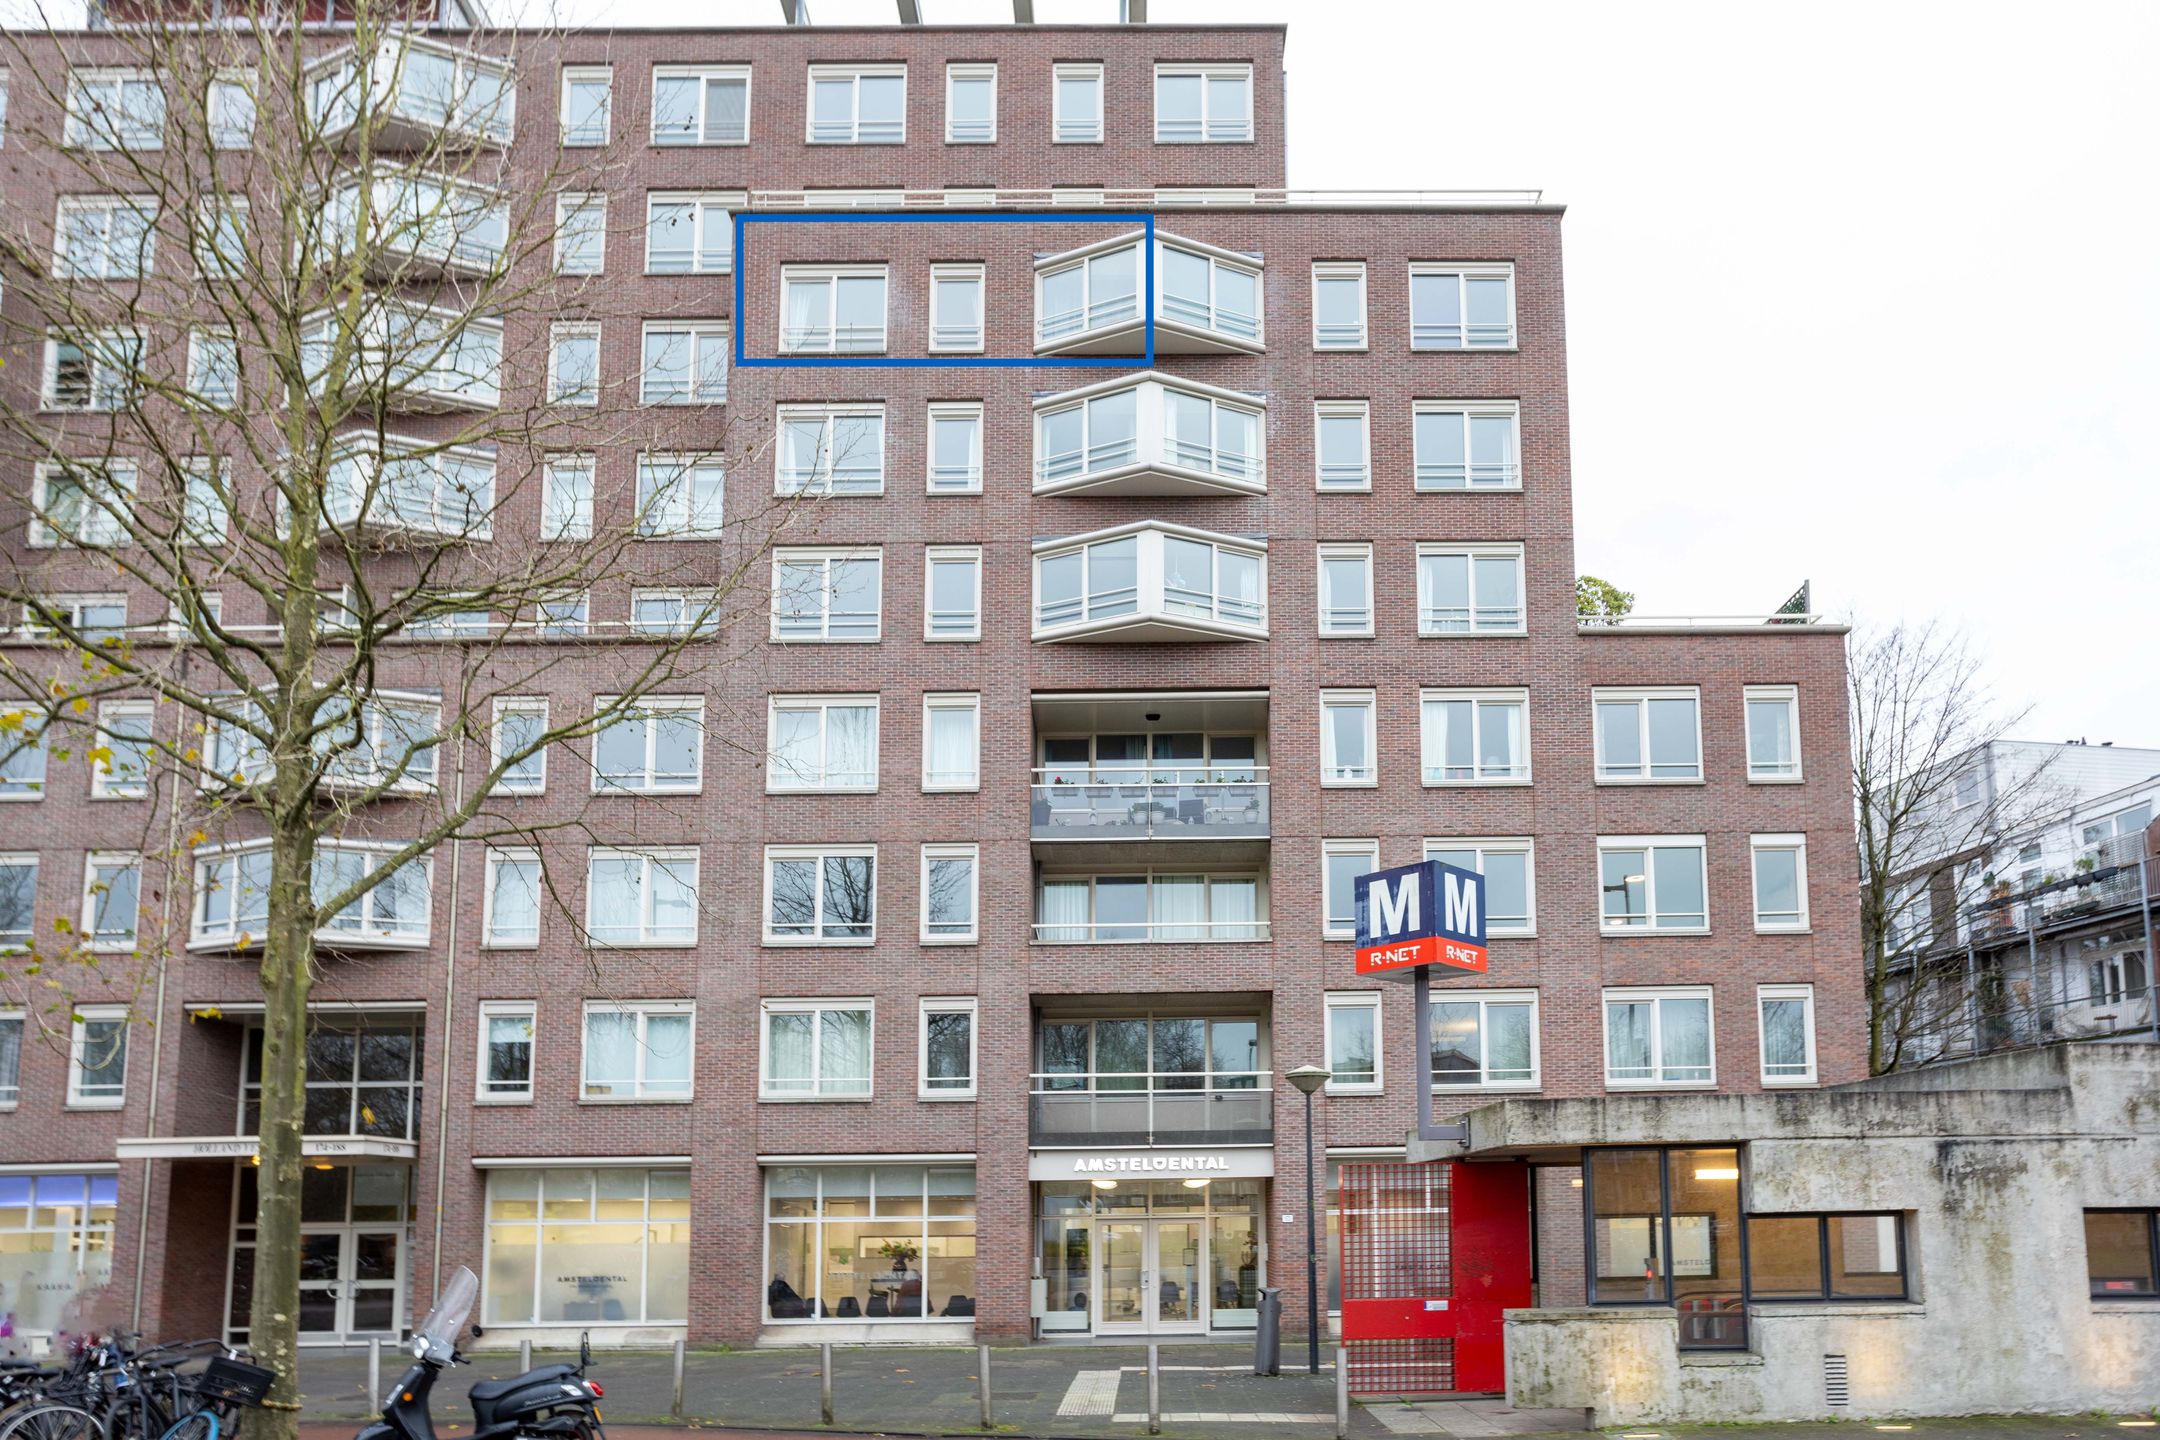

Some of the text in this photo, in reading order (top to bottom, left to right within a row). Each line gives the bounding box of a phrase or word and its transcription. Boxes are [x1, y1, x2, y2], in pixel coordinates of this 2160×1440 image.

[1369, 872, 1420, 939] M
[1444, 871, 1478, 938] M
[1073, 1156, 1229, 1172] AMSTELDENTAL
